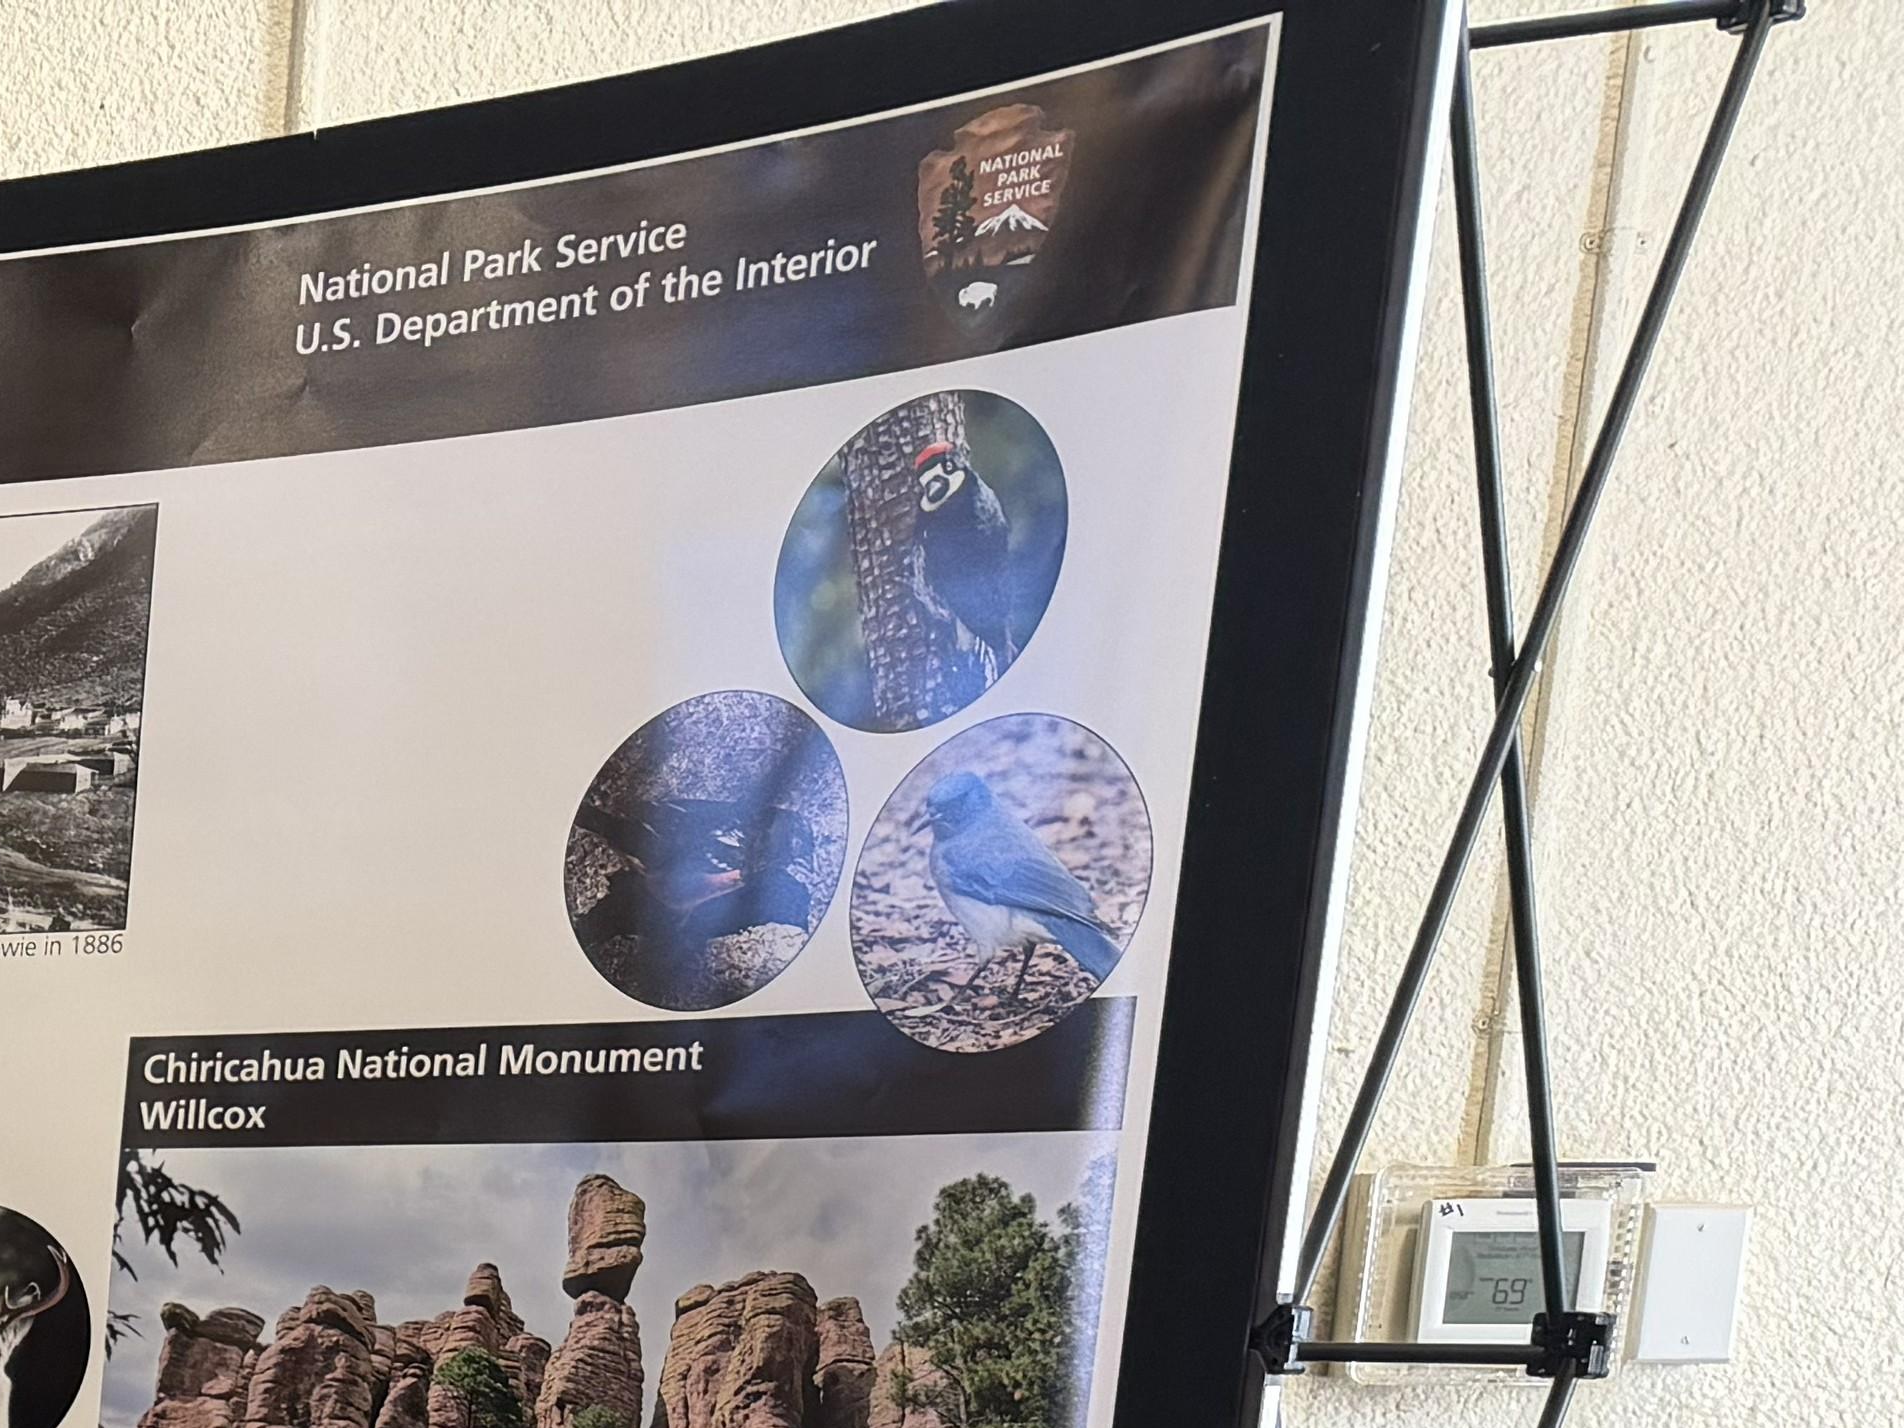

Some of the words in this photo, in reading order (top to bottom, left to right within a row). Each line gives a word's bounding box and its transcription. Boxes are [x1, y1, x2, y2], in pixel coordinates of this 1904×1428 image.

[979, 143, 1065, 175] NATIONAL
[996, 165, 1042, 188] PARK
[982, 179, 1053, 208] SERVICE
[298, 254, 450, 307] National
[462, 241, 542, 286] Park
[555, 218, 688, 271] Service
[294, 316, 362, 356] U.S.
[374, 286, 598, 350] Department
[608, 275, 651, 313] of
[661, 265, 723, 304] the
[734, 233, 877, 296] Interior
[41, 935, 61, 960] in
[69, 932, 125, 957] 1886
[142, 1051, 326, 1086] Chiricahua
[336, 1043, 487, 1080] National
[498, 1040, 705, 1077] Monument
[139, 1099, 267, 1132] Willcox
[1438, 1202, 1465, 1218] #1
